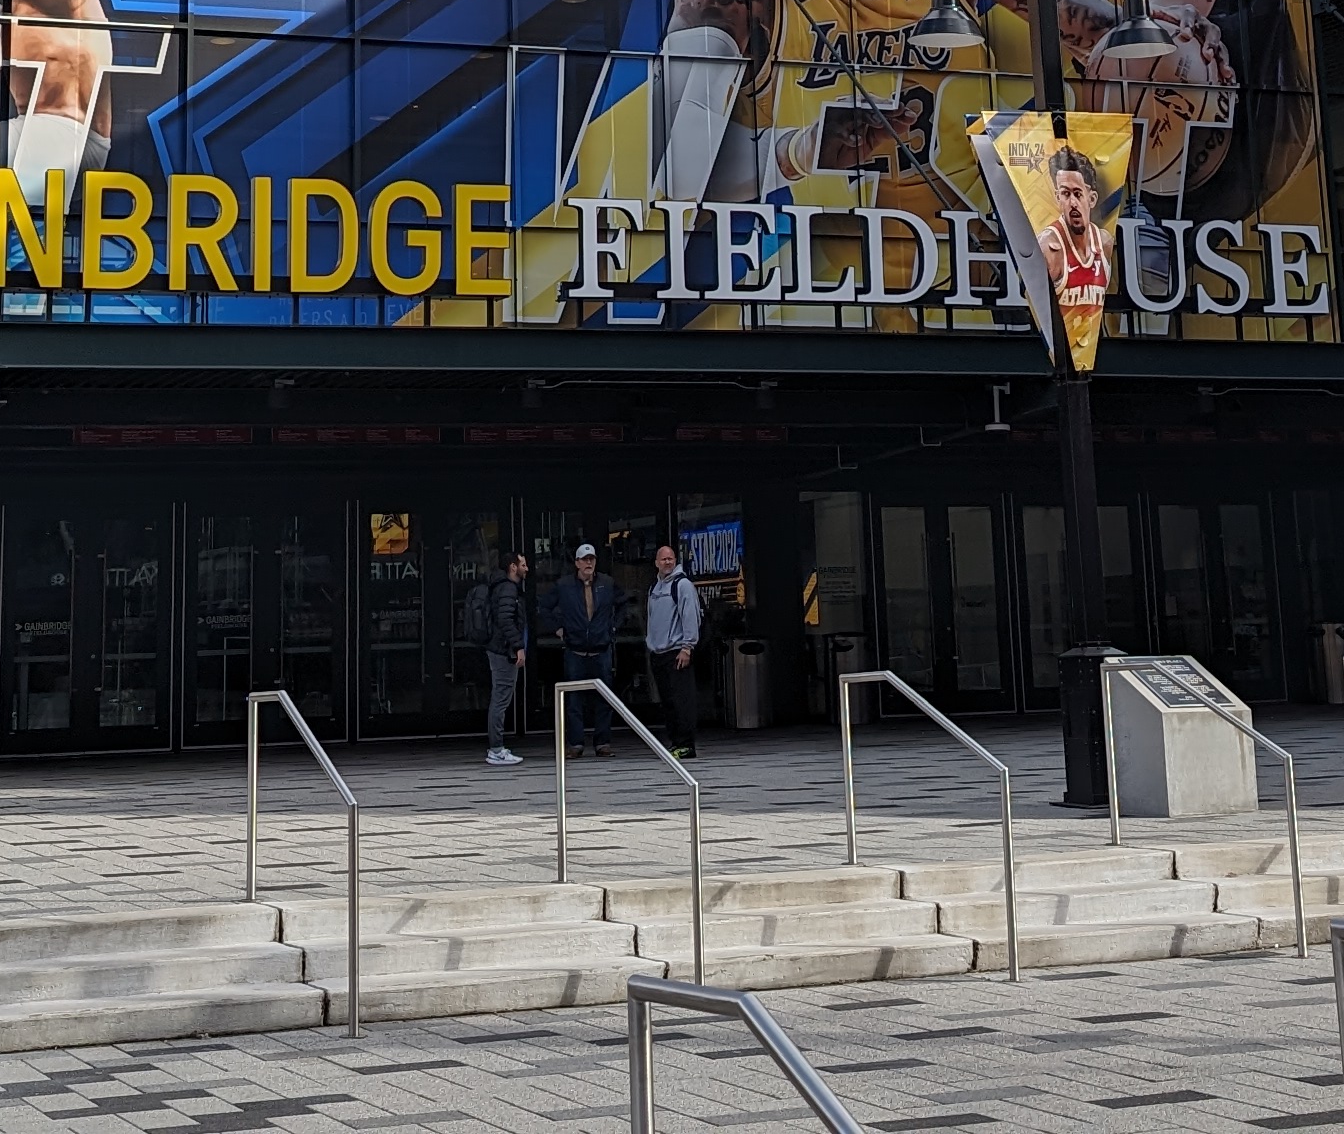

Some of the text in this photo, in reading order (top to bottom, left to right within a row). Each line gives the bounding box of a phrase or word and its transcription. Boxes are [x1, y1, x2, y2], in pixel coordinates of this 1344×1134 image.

[1008, 142, 1046, 157] INDY 24
[567, 196, 1331, 317] FIELDHUSE
